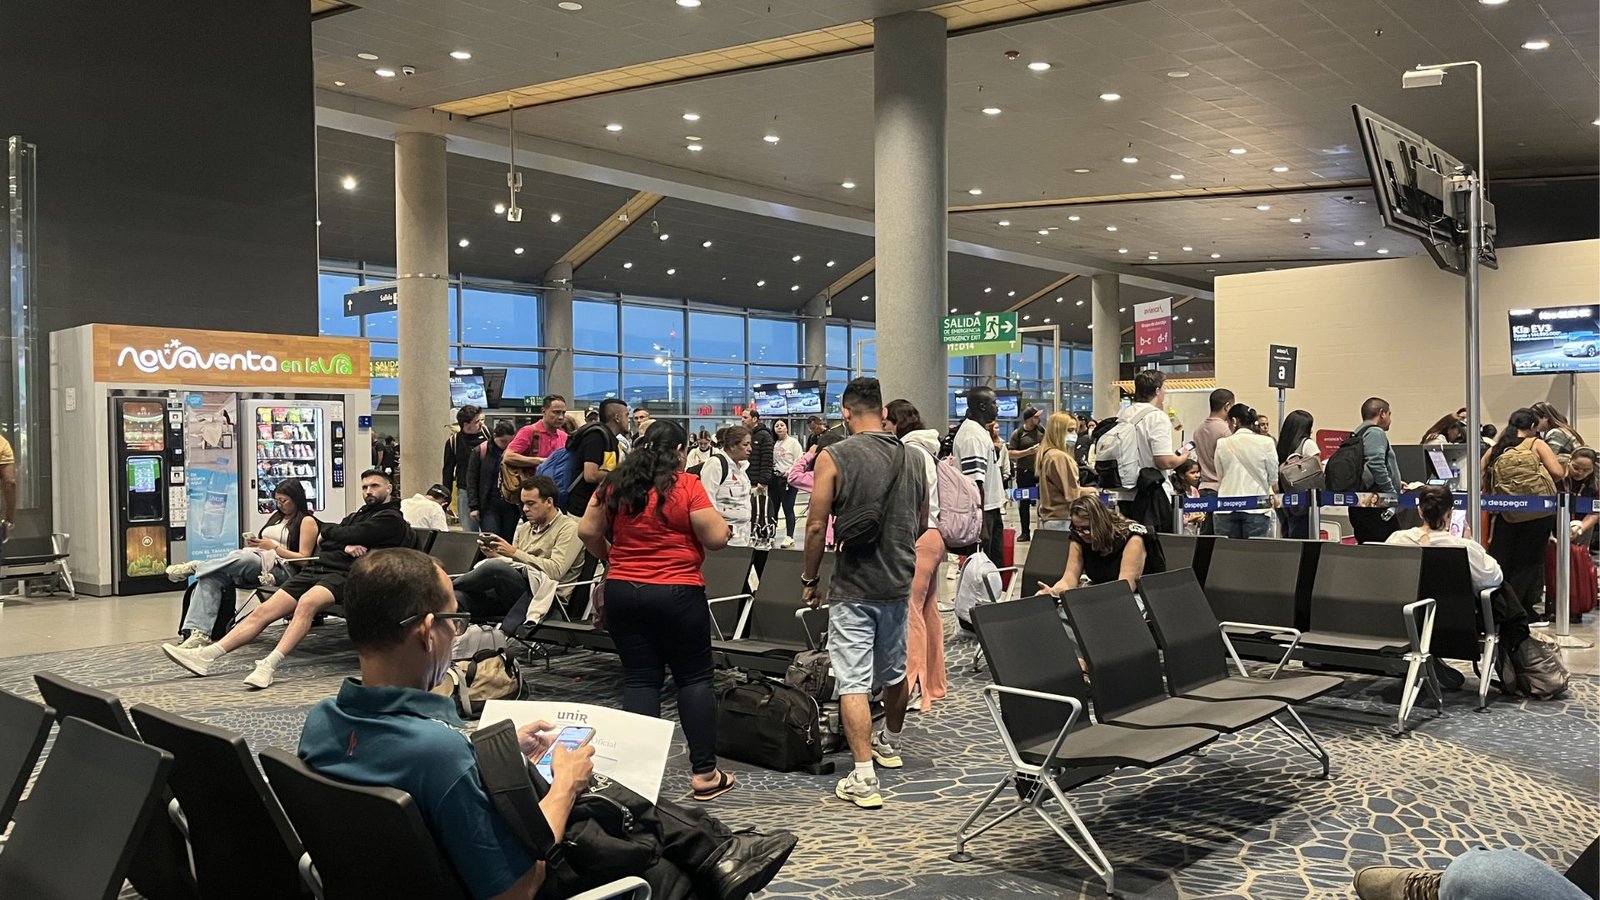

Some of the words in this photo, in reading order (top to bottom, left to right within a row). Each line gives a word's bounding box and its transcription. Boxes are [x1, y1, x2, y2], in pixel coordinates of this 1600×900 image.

[944, 317, 981, 329] SALIDA
[951, 327, 981, 335] EMERGENCIA
[1512, 325, 1530, 333] Kia
[1531, 324, 1552, 332] EV3
[1140, 336, 1151, 346] b-c
[1157, 332, 1168, 343] d-f
[281, 360, 301, 373] en
[1278, 365, 1286, 380] a
[1184, 501, 1209, 509] despegar
[1223, 500, 1247, 508] despegar
[1487, 499, 1528, 508] despegar
